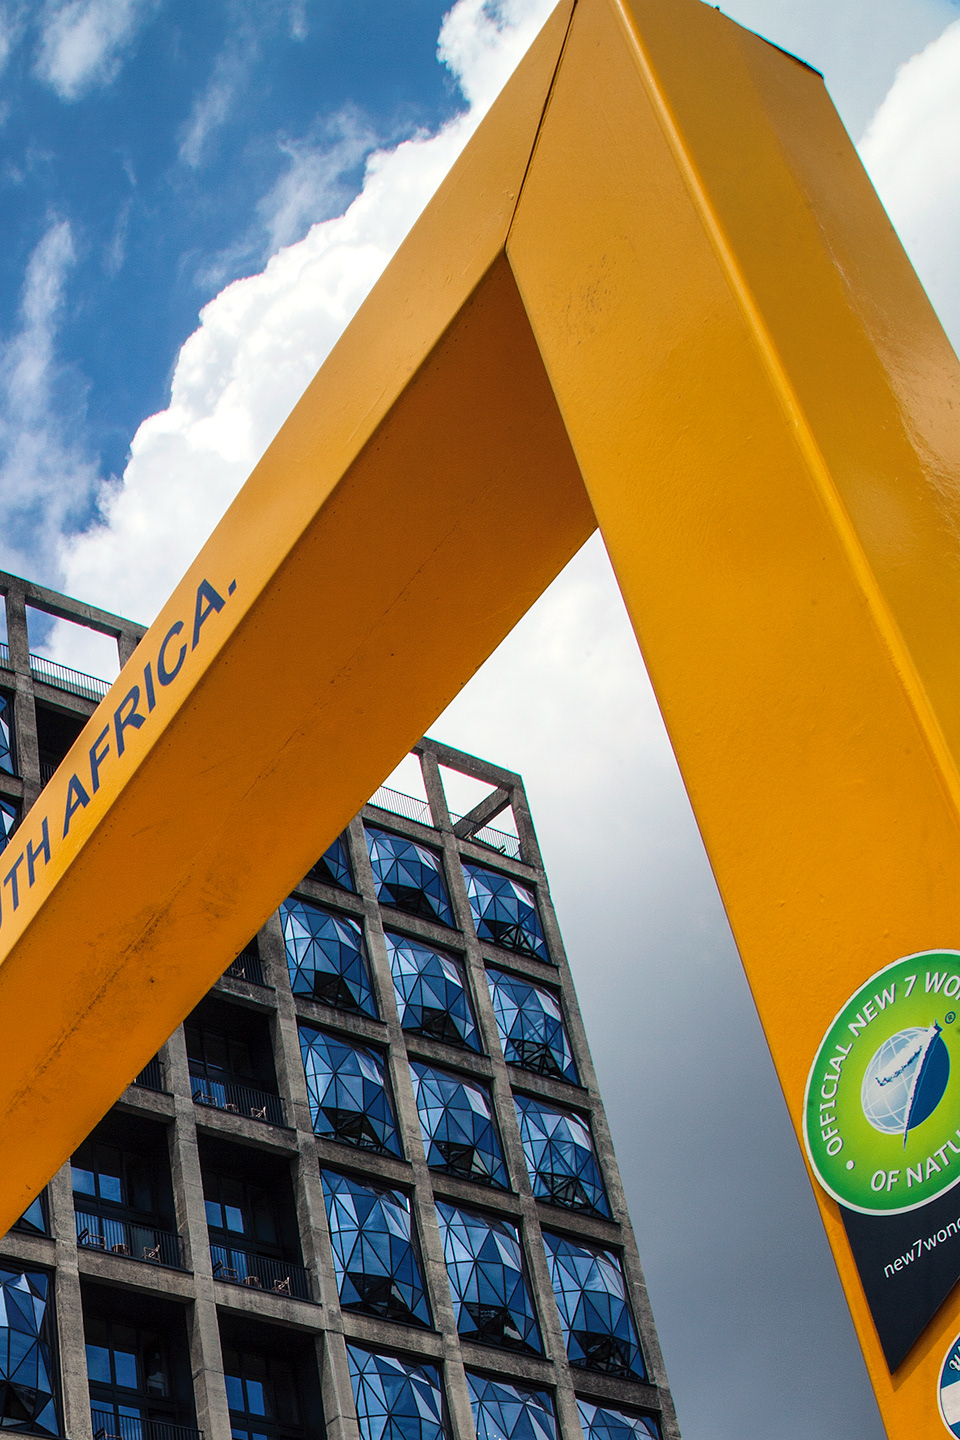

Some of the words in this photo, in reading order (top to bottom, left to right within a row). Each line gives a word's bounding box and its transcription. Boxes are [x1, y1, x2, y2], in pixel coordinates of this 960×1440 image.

[62, 577, 237, 841] AFRICA.
[819, 1042, 854, 1157] OFFICIAL
[847, 983, 897, 1037] NEW
[904, 974, 918, 998] 7
[924, 971, 960, 1001] WO
[870, 1169, 901, 1192] OF
[883, 1216, 960, 1279] new7won
